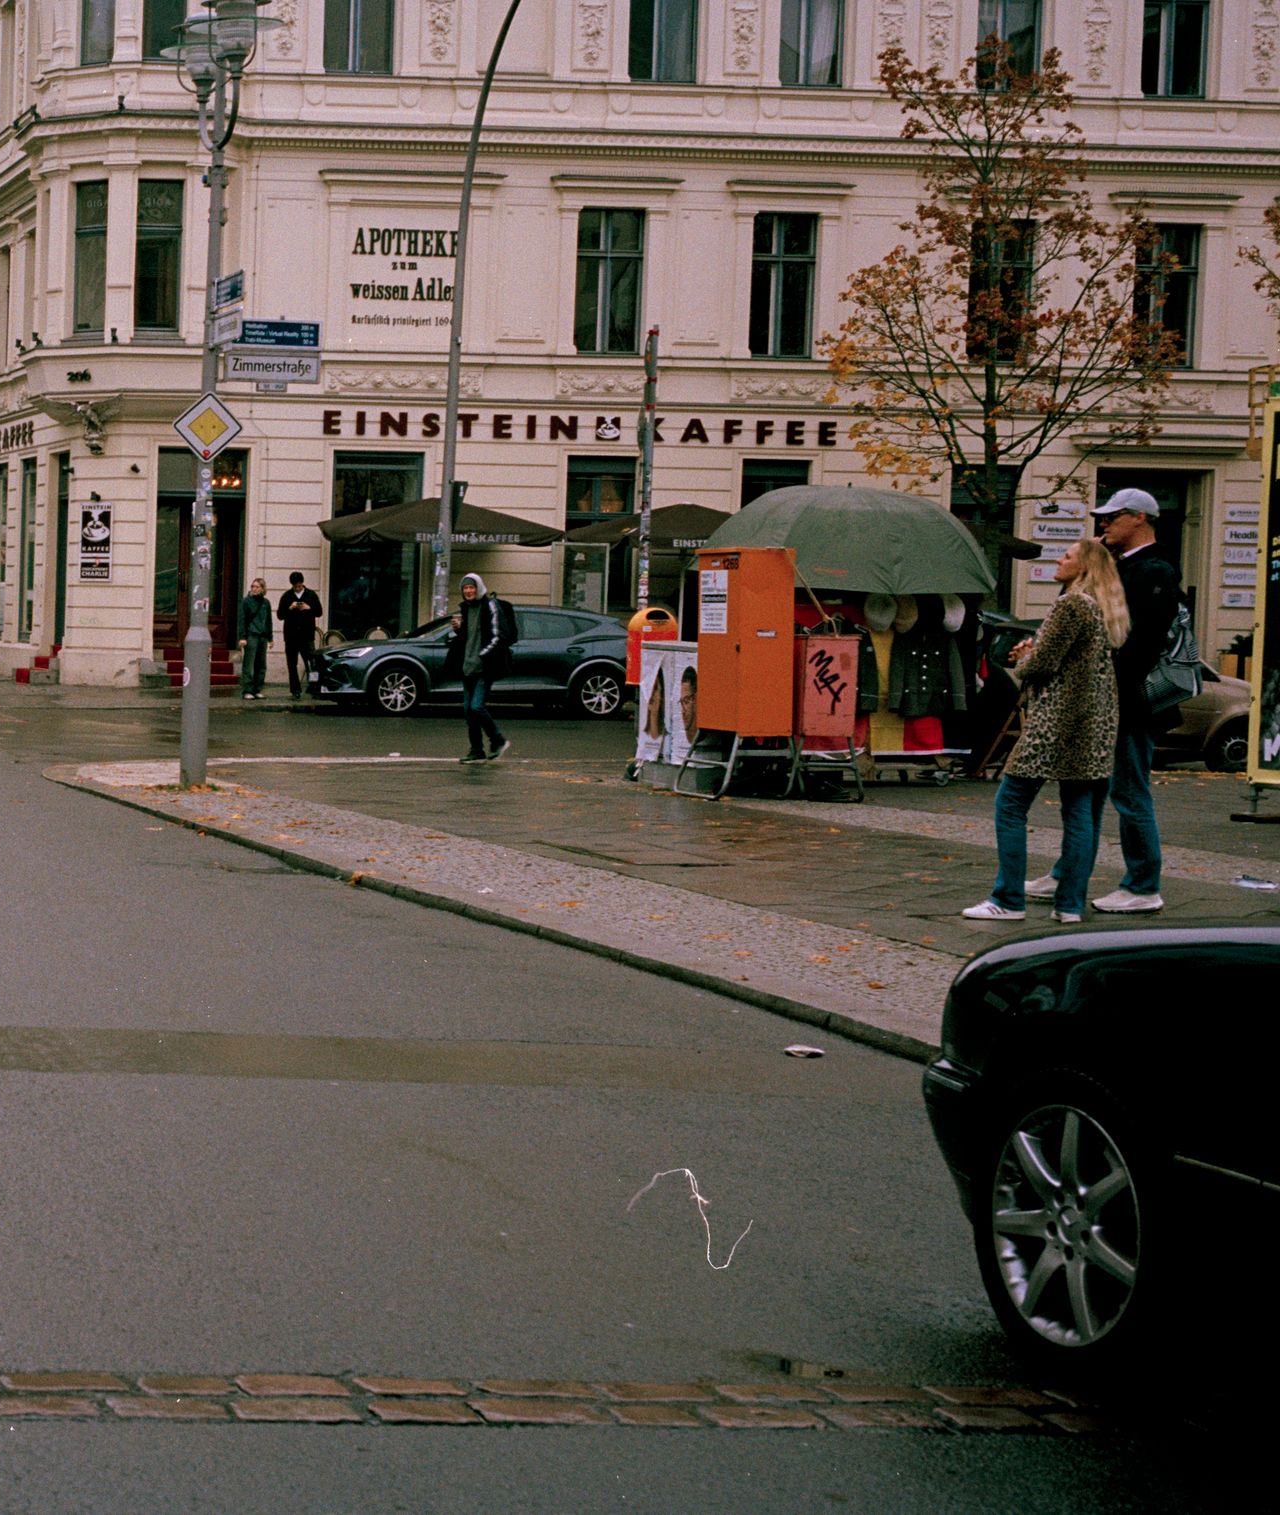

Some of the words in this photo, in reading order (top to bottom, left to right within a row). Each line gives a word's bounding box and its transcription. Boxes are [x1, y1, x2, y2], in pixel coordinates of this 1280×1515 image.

[352, 227, 458, 257] APOTHEKE
[392, 262, 417, 270] zum
[350, 280, 409, 300] weissen
[435, 317, 453, 326] 169
[232, 357, 312, 376] Zimmerstraße
[323, 410, 578, 440] EINSTEIN
[416, 532, 467, 542] EINEIN
[479, 534, 520, 542] KAFFEE
